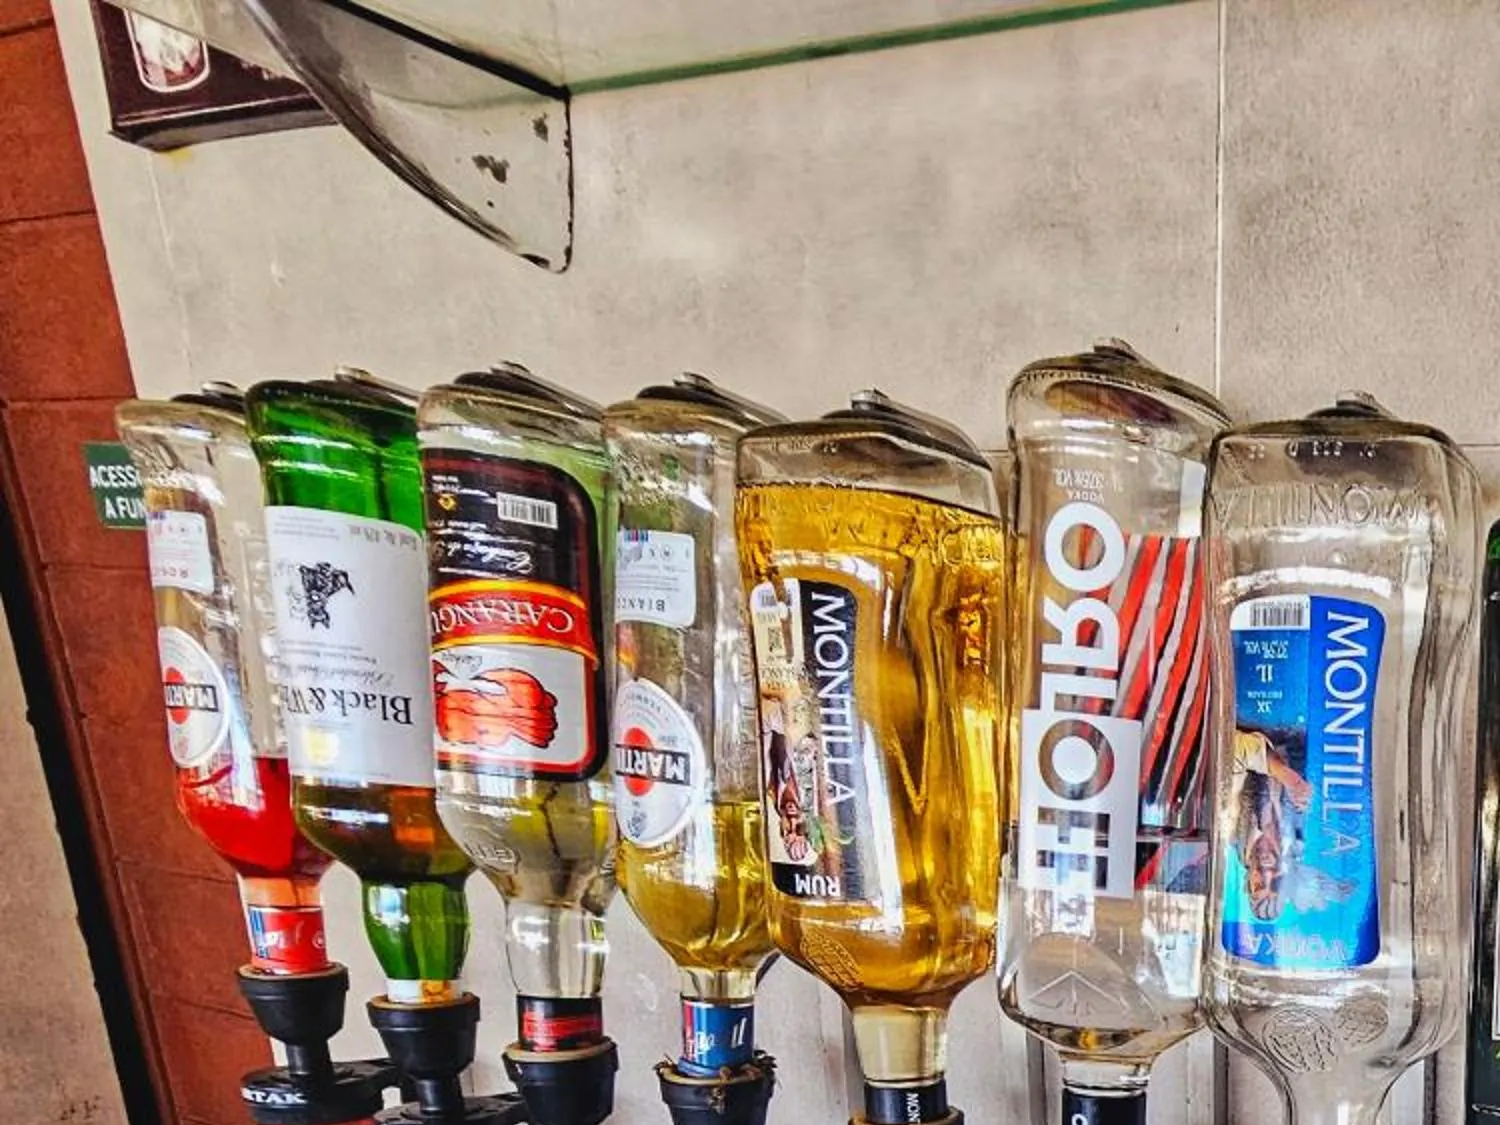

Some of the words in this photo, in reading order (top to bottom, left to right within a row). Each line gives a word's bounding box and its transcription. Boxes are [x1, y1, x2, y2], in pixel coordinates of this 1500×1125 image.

[105, 497, 117, 519] A
[308, 687, 327, 713] &
[332, 689, 414, 725] Black
[810, 591, 857, 807] MONTILLA
[1319, 611, 1370, 857] MONTILLA
[794, 872, 842, 897] RUM
[1244, 930, 1348, 964] VODKA
